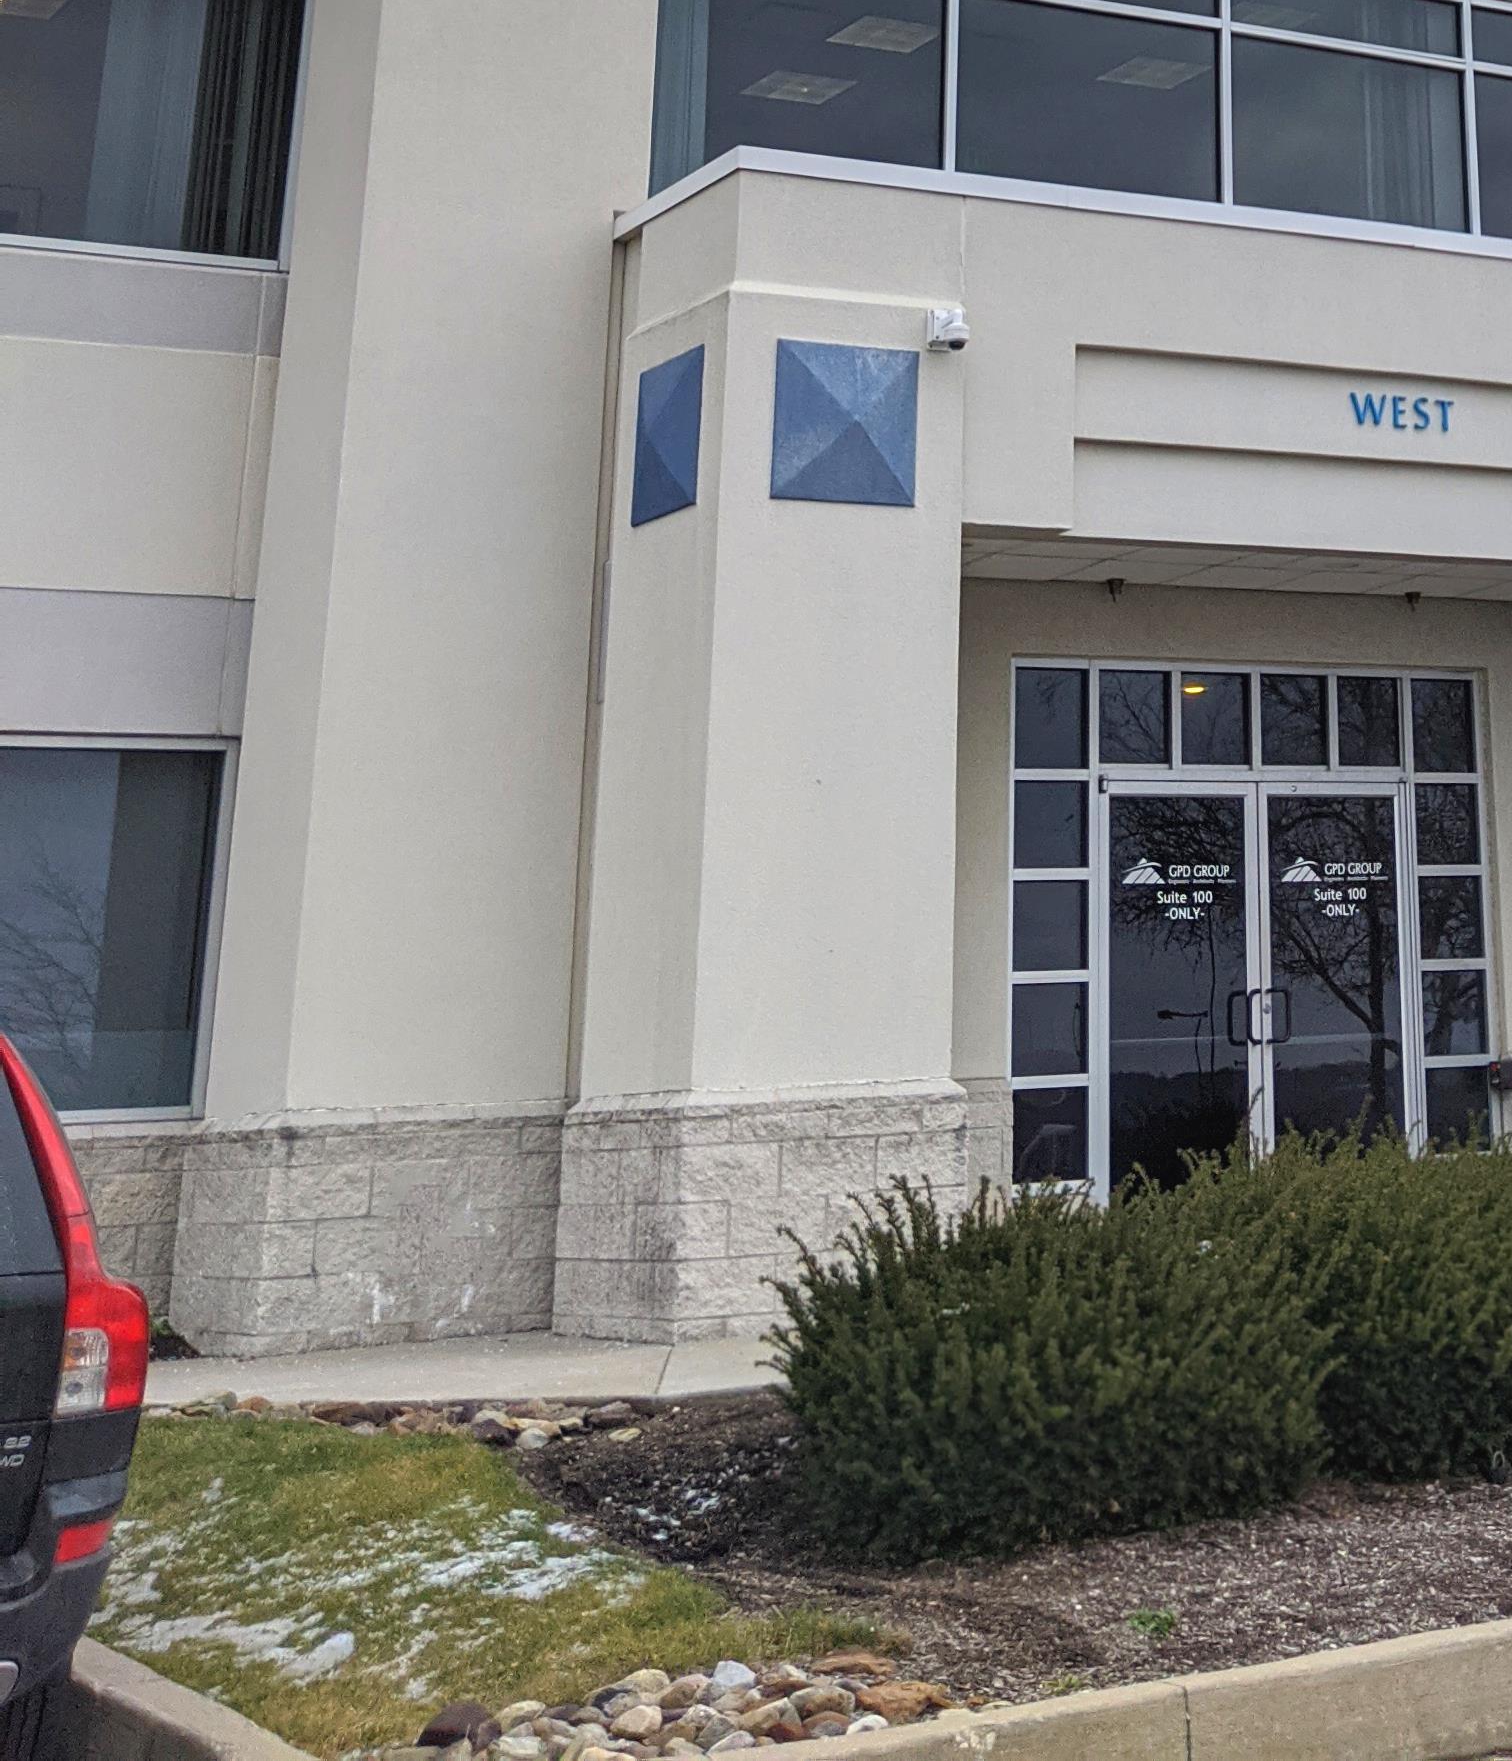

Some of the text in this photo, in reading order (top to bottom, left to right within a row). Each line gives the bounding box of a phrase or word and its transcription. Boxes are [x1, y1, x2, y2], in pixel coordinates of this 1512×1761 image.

[1350, 392, 1455, 432] WEST
[1168, 864, 1230, 877] GPD GROUP
[1324, 862, 1382, 875] GPD GROUP
[1157, 890, 1213, 904] Suite 100
[1314, 887, 1367, 901] Suite 100
[1165, 907, 1205, 920] -ONLY-
[1321, 903, 1360, 917] -ONLY-
